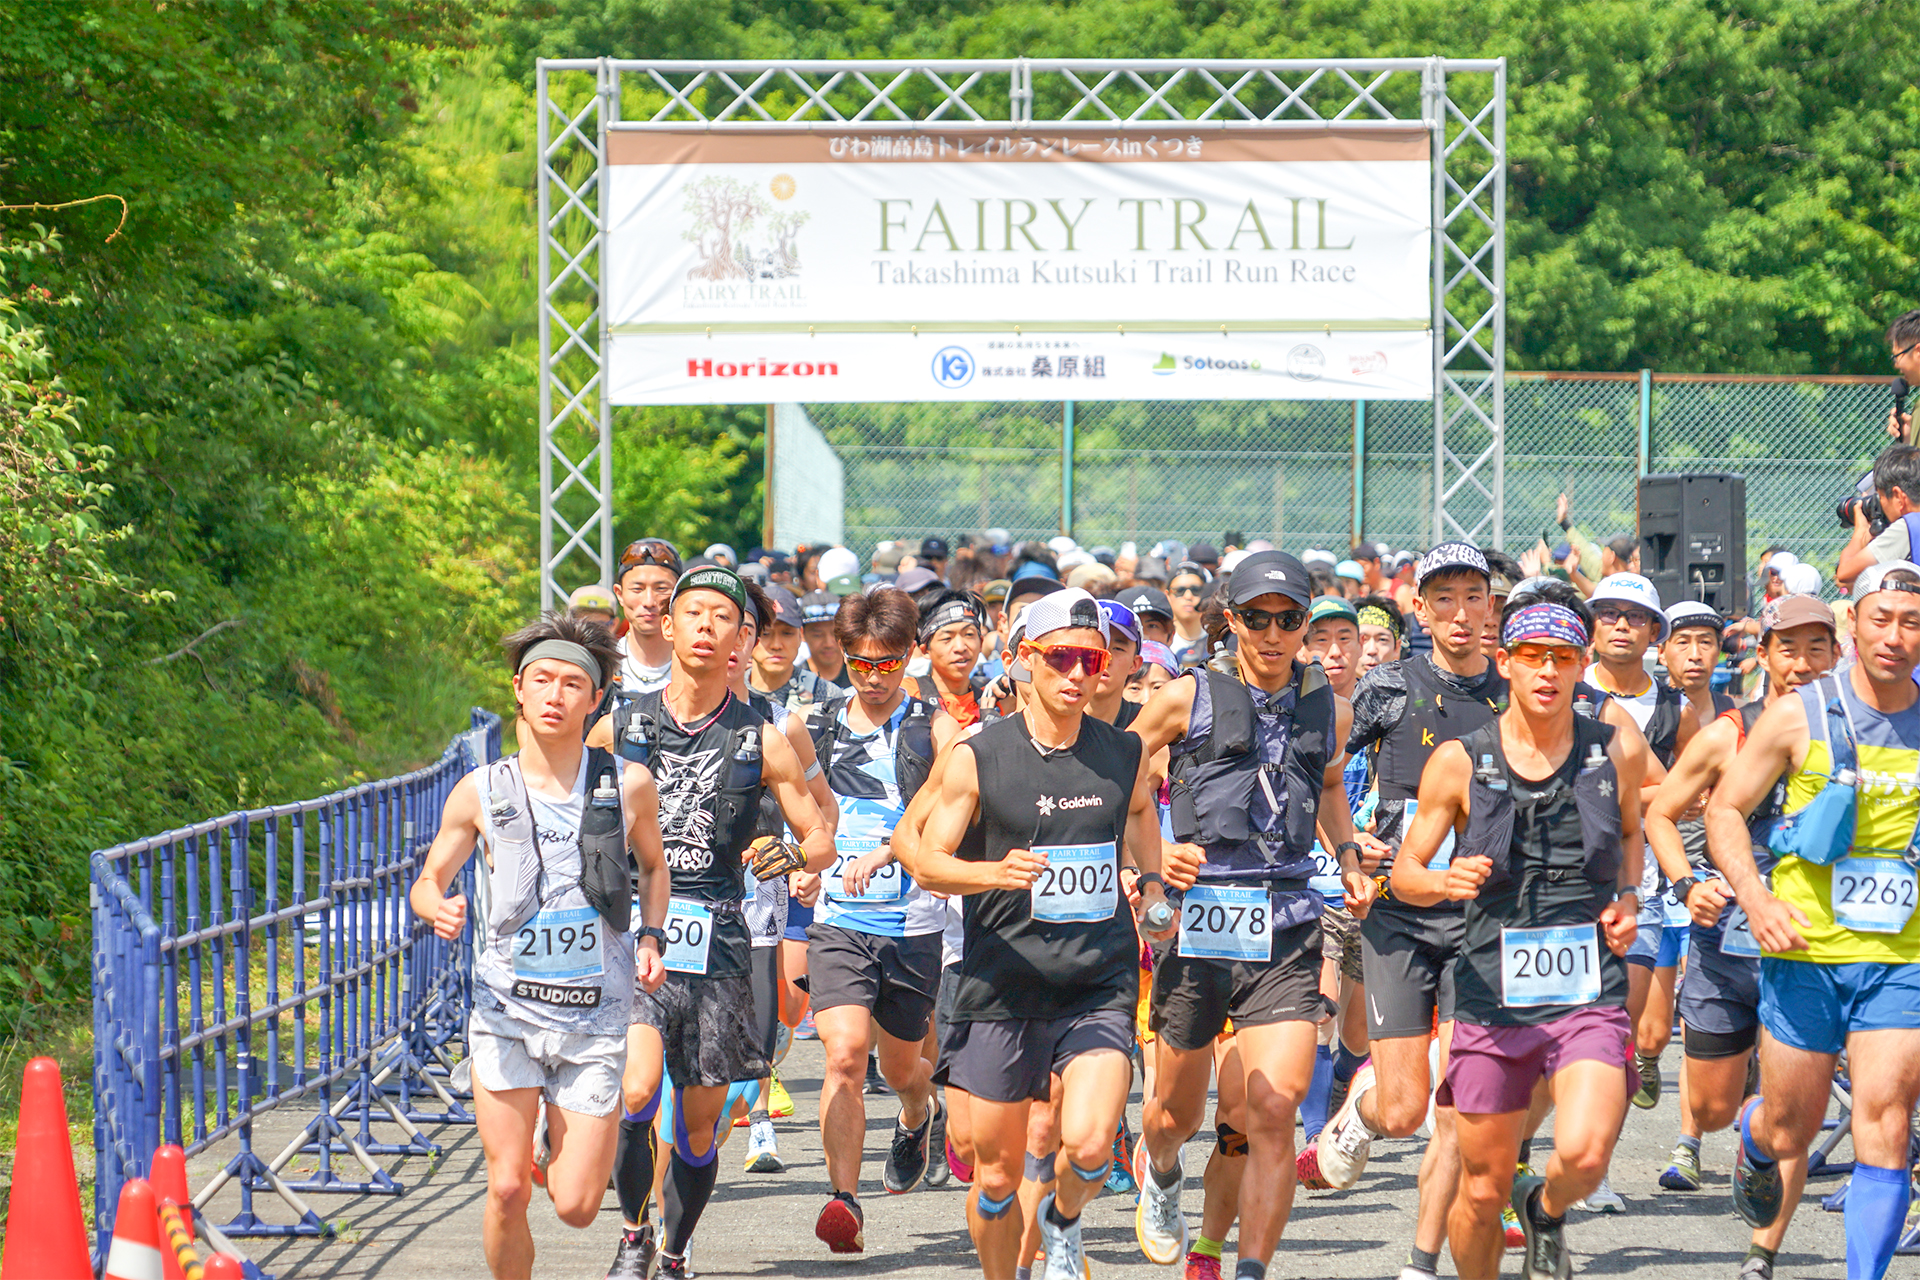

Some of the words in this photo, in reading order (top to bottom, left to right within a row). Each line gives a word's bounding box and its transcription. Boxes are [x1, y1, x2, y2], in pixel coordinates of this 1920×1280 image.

[828, 135, 1204, 159] びわ湖高島トレイルランレースinくつき
[873, 198, 1099, 252] FAIRY
[1118, 197, 1356, 252] TRAIL
[871, 259, 1020, 285] Takashima
[1031, 259, 1138, 284] Kutsuki
[1147, 259, 1212, 284] Trail
[1225, 259, 1279, 283] Run
[1289, 258, 1357, 283] Race
[683, 284, 741, 300] FAIRY
[745, 284, 808, 300] TRAIL
[687, 357, 839, 378] Horizon
[982, 366, 1027, 377] 株式会社
[1031, 354, 1107, 378] 桑原組
[1609, 579, 1644, 592] HOKA
[1058, 794, 1103, 810] Goldwin
[1052, 849, 1078, 857] FAIRY
[1079, 848, 1102, 856] TRAIL
[1038, 863, 1113, 897] 2002
[1203, 888, 1229, 897] FAIRY
[1230, 890, 1254, 898] TRAIL
[1839, 875, 1914, 908] 2262
[558, 910, 582, 919] TRAIL
[670, 902, 693, 911] TRAIL
[1186, 903, 1266, 935] 2078
[518, 922, 597, 957] 2195
[1525, 931, 1550, 939] FAIRY
[1553, 930, 1577, 938] TRAIL
[1513, 944, 1590, 979] 2001
[516, 983, 597, 1005] STUDIO.G
